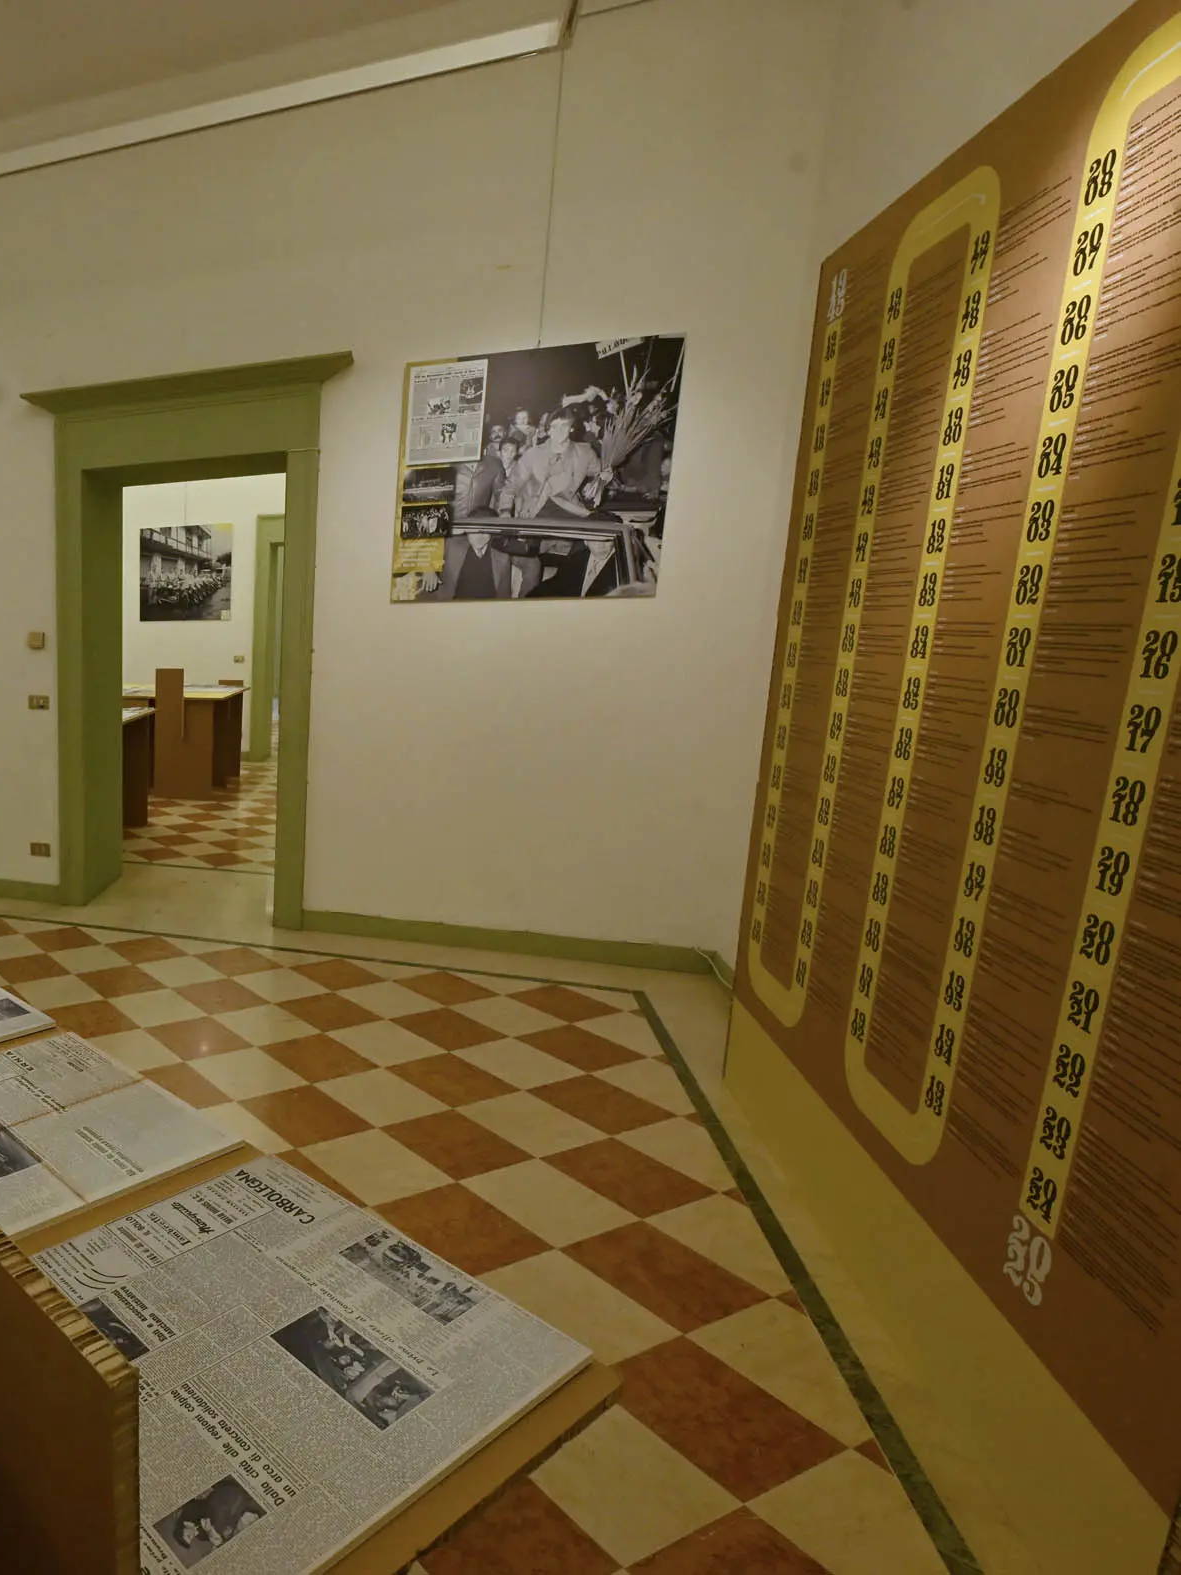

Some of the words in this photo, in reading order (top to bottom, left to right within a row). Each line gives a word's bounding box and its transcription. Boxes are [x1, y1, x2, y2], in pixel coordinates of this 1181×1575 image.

[3, 1050, 34, 1071] ERNIA
[233, 1168, 316, 1226] CARBOLEGNA
[125, 1215, 145, 1231] BOLLO
[147, 1212, 191, 1246] Lambretta
[171, 1201, 214, 1234] Mosquito
[1008, 1215, 1051, 1277] 20
[1003, 1239, 1044, 1305] 25
[111, 1289, 147, 1321] associazioni
[120, 1285, 147, 1311] iniziative
[148, 1312, 176, 1338] lanciano
[152, 1328, 167, 1342] Enti
[170, 1389, 194, 1412] colpite
[180, 1382, 218, 1418] solidarietà
[194, 1413, 221, 1440] regioni
[217, 1419, 250, 1451] concreta
[222, 1441, 239, 1457] alle
[248, 1452, 262, 1462] di
[238, 1459, 259, 1478] città
[262, 1463, 283, 1483] arco
[260, 1481, 285, 1506] Dalla
[282, 1484, 296, 1497] un
